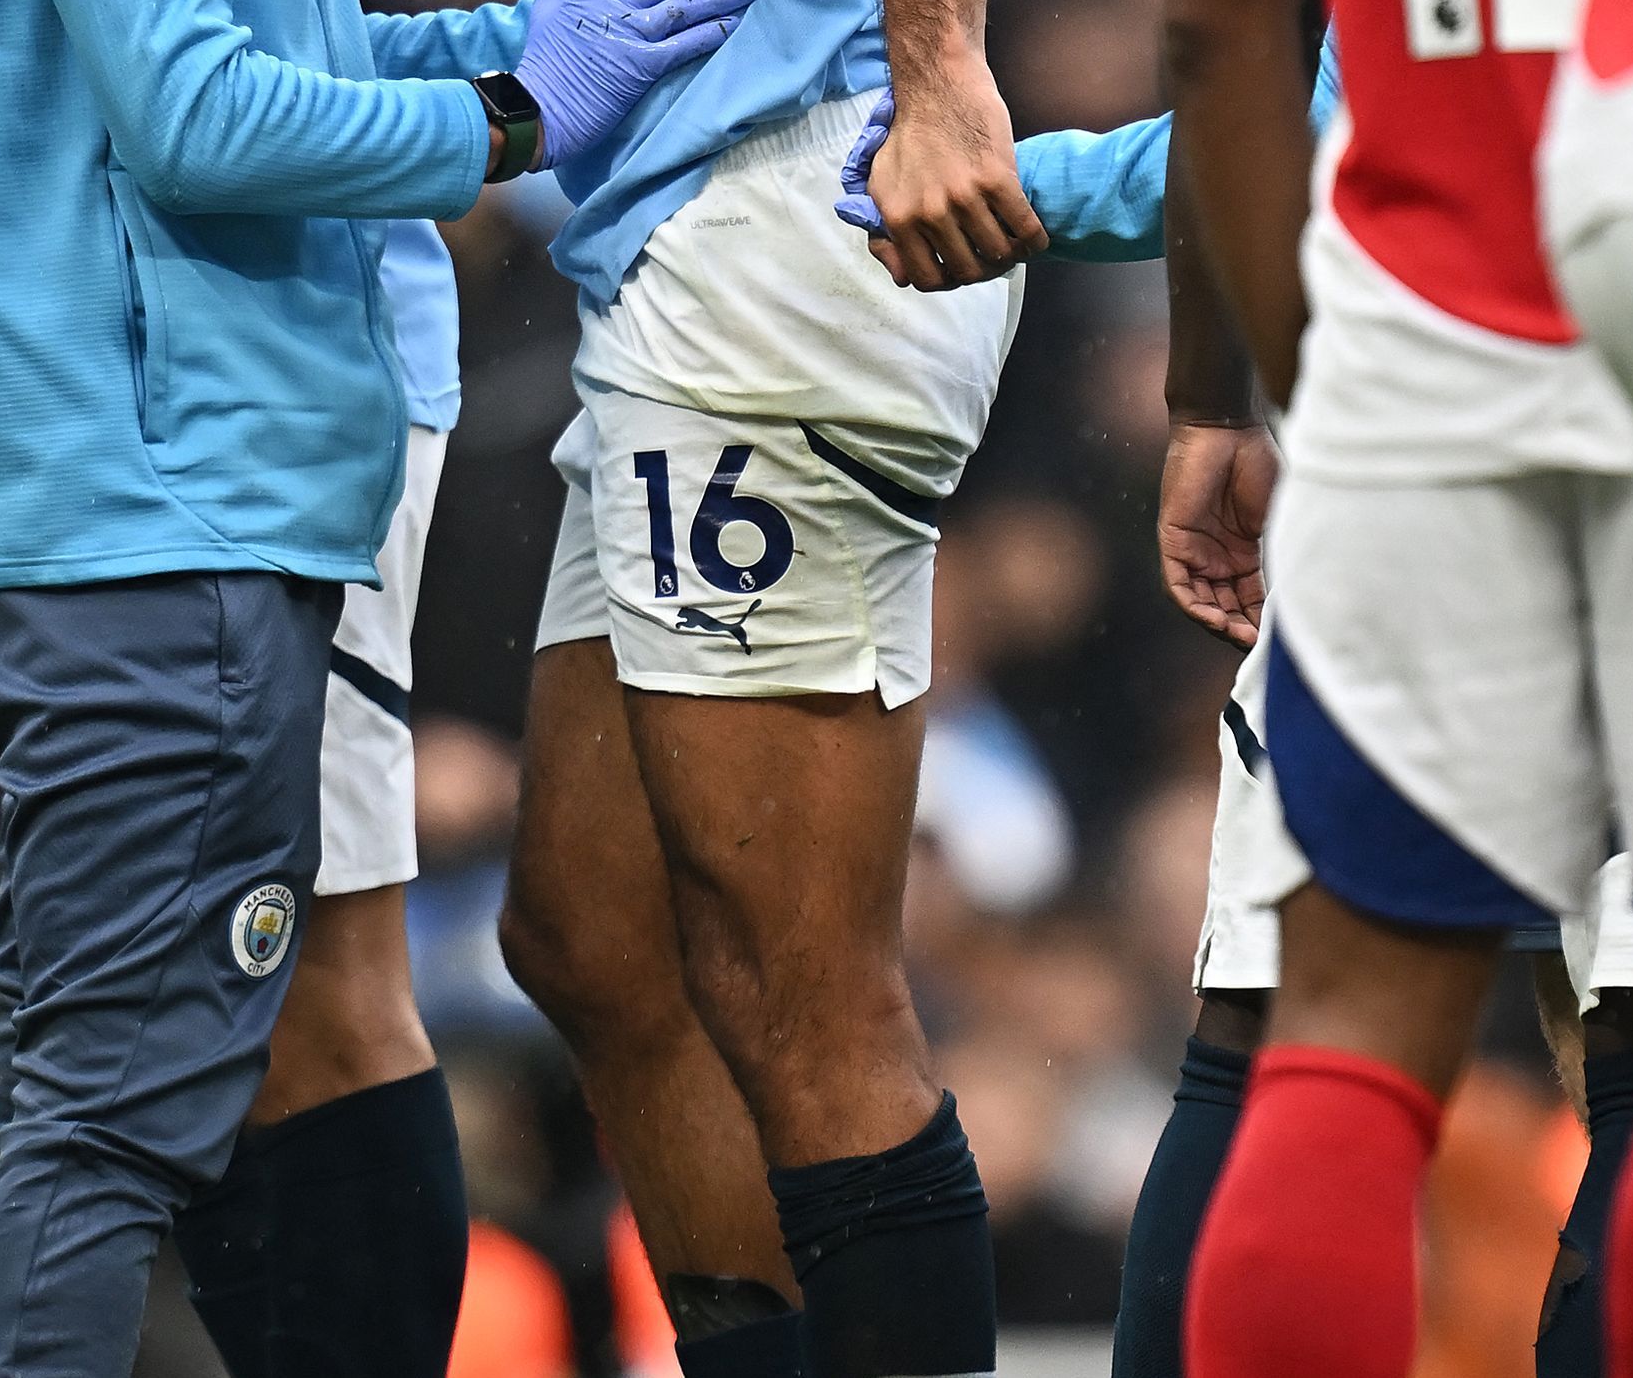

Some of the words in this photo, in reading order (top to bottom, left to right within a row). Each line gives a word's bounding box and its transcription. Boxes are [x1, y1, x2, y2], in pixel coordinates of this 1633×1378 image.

[690, 215, 752, 230] ULTRAWEAVE
[633, 443, 796, 599] 16
[244, 886, 295, 921] MANCHESTER
[246, 962, 267, 975] CITY
